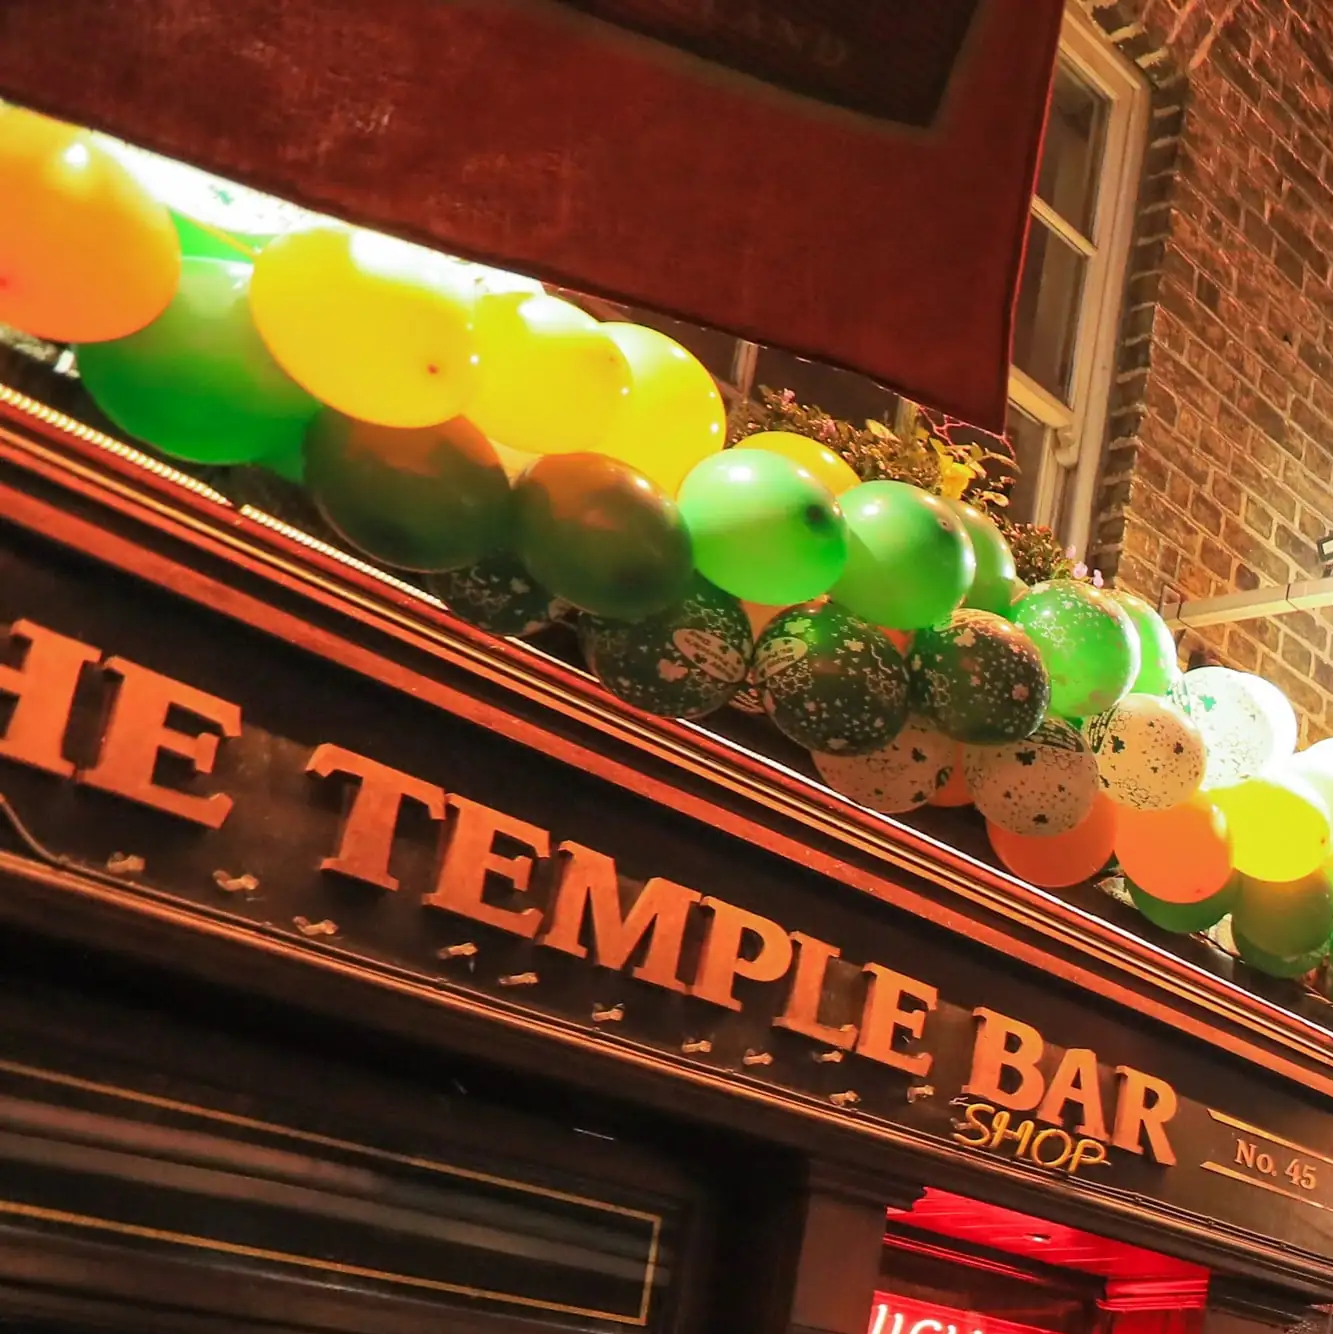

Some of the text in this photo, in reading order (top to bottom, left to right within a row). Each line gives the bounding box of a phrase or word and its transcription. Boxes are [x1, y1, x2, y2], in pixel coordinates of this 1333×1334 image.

[305, 743, 938, 1077] TEMPLE
[962, 1006, 1178, 1167] BAR
[953, 1102, 1110, 1175] SHOP
[1234, 1139, 1317, 1190] No. 45
